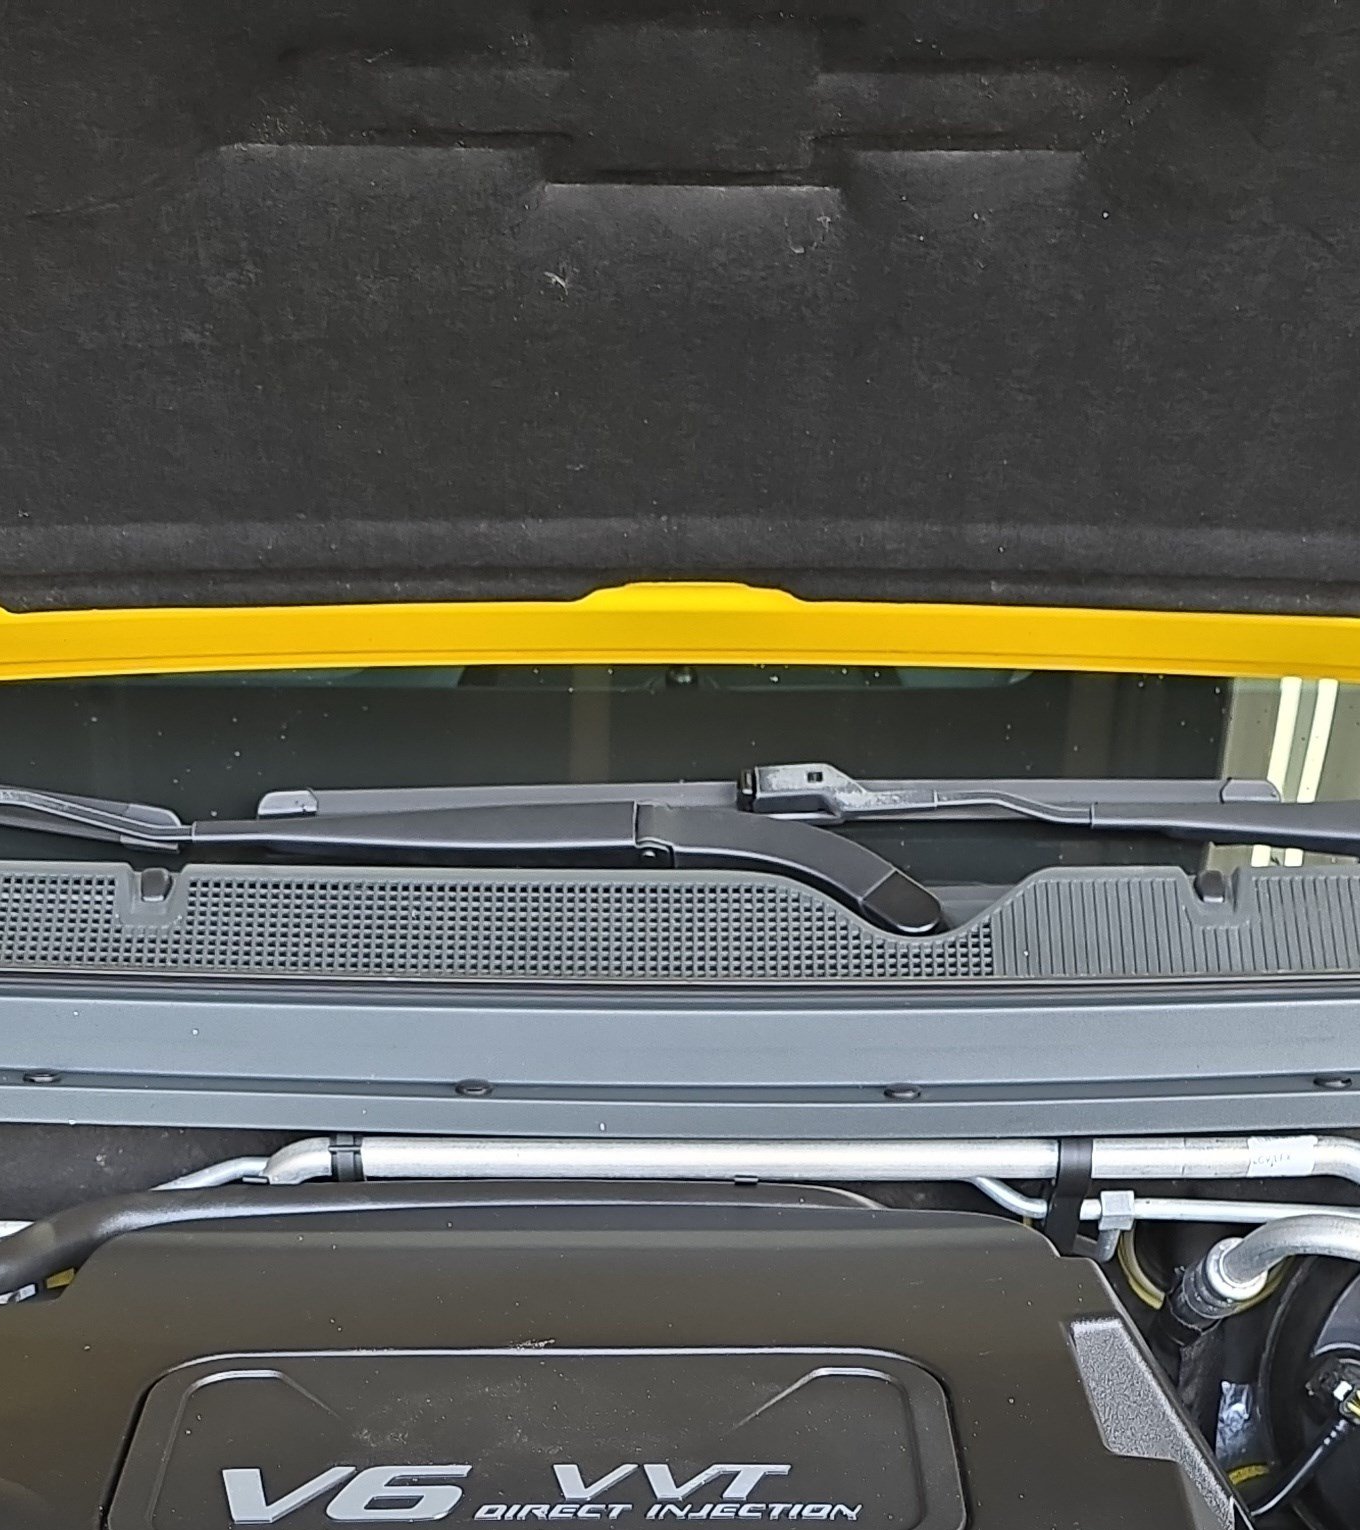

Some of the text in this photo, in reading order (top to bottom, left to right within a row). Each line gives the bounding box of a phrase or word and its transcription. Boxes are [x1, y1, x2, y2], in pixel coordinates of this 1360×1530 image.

[221, 1463, 792, 1526] V6 VVT
[473, 1503, 862, 1521] DIRECT INJECTION
